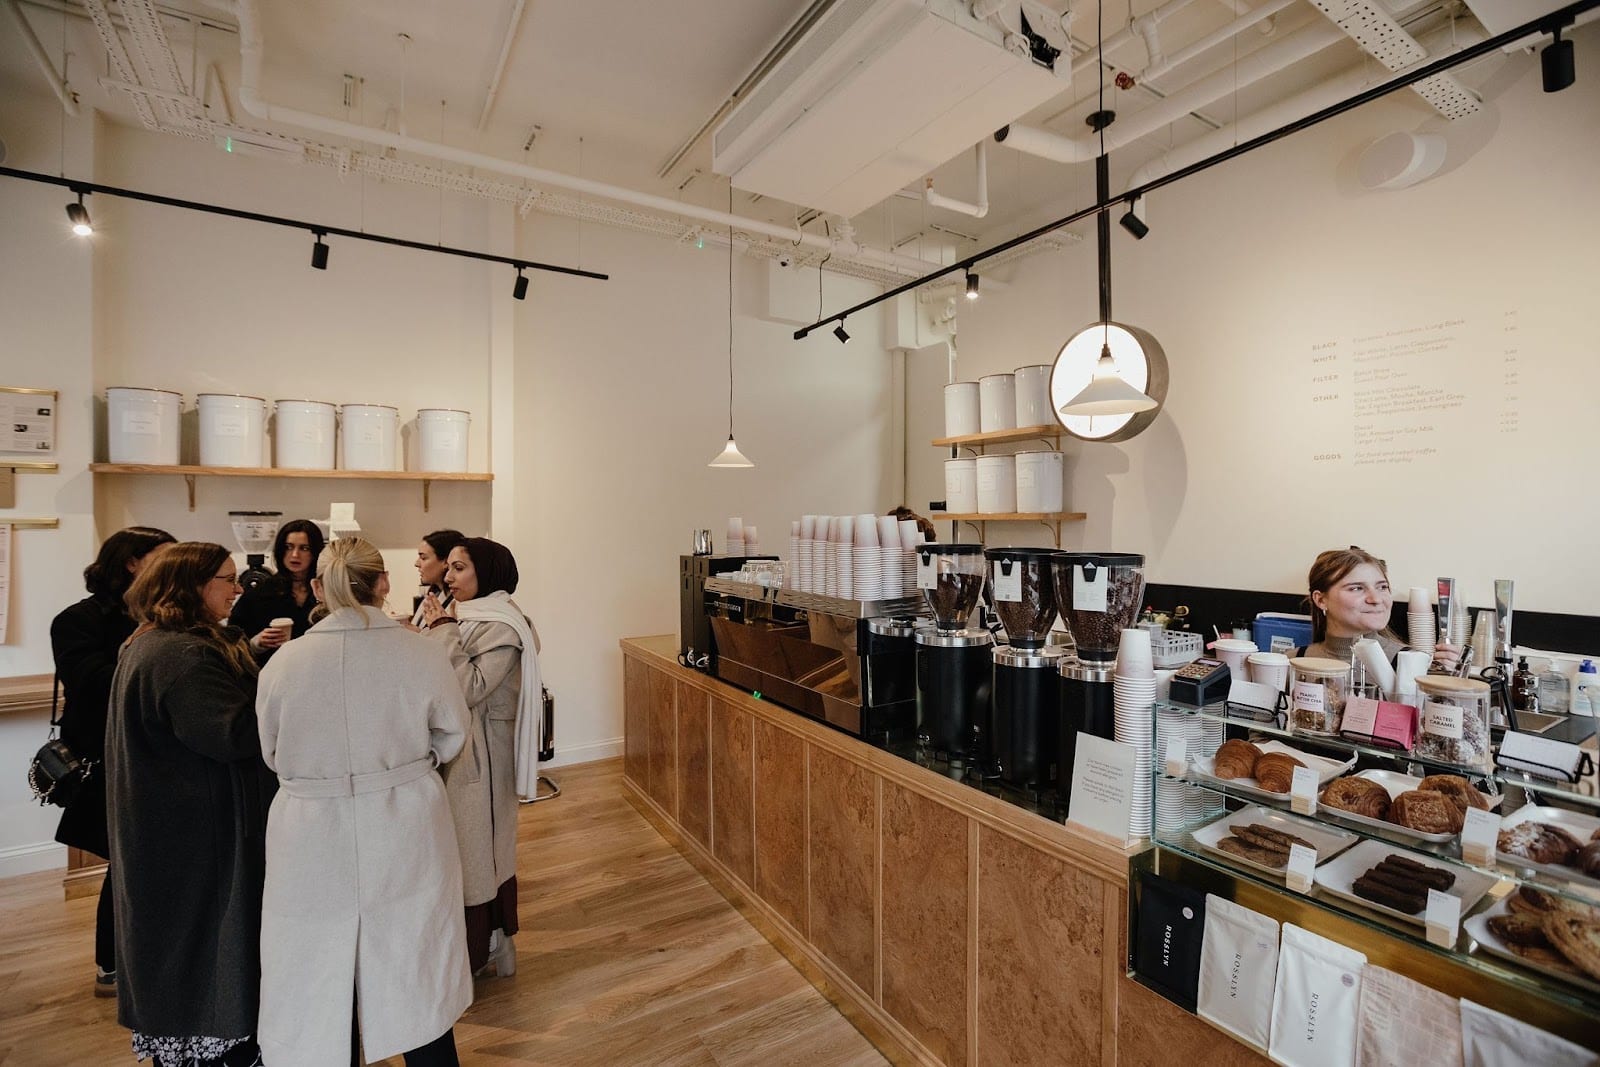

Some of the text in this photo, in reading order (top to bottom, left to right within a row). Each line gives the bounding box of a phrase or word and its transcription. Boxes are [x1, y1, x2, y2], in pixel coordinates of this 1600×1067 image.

[1312, 342, 1337, 351] BLACK
[1312, 355, 1337, 364] WHITE
[1312, 374, 1339, 383] FILTER
[1429, 719, 1456, 729] CARAMEL
[1160, 925, 1172, 966] ROSSLYN
[1231, 953, 1242, 998] ROSSLYN
[1307, 992, 1319, 1041] ROSSLYN
